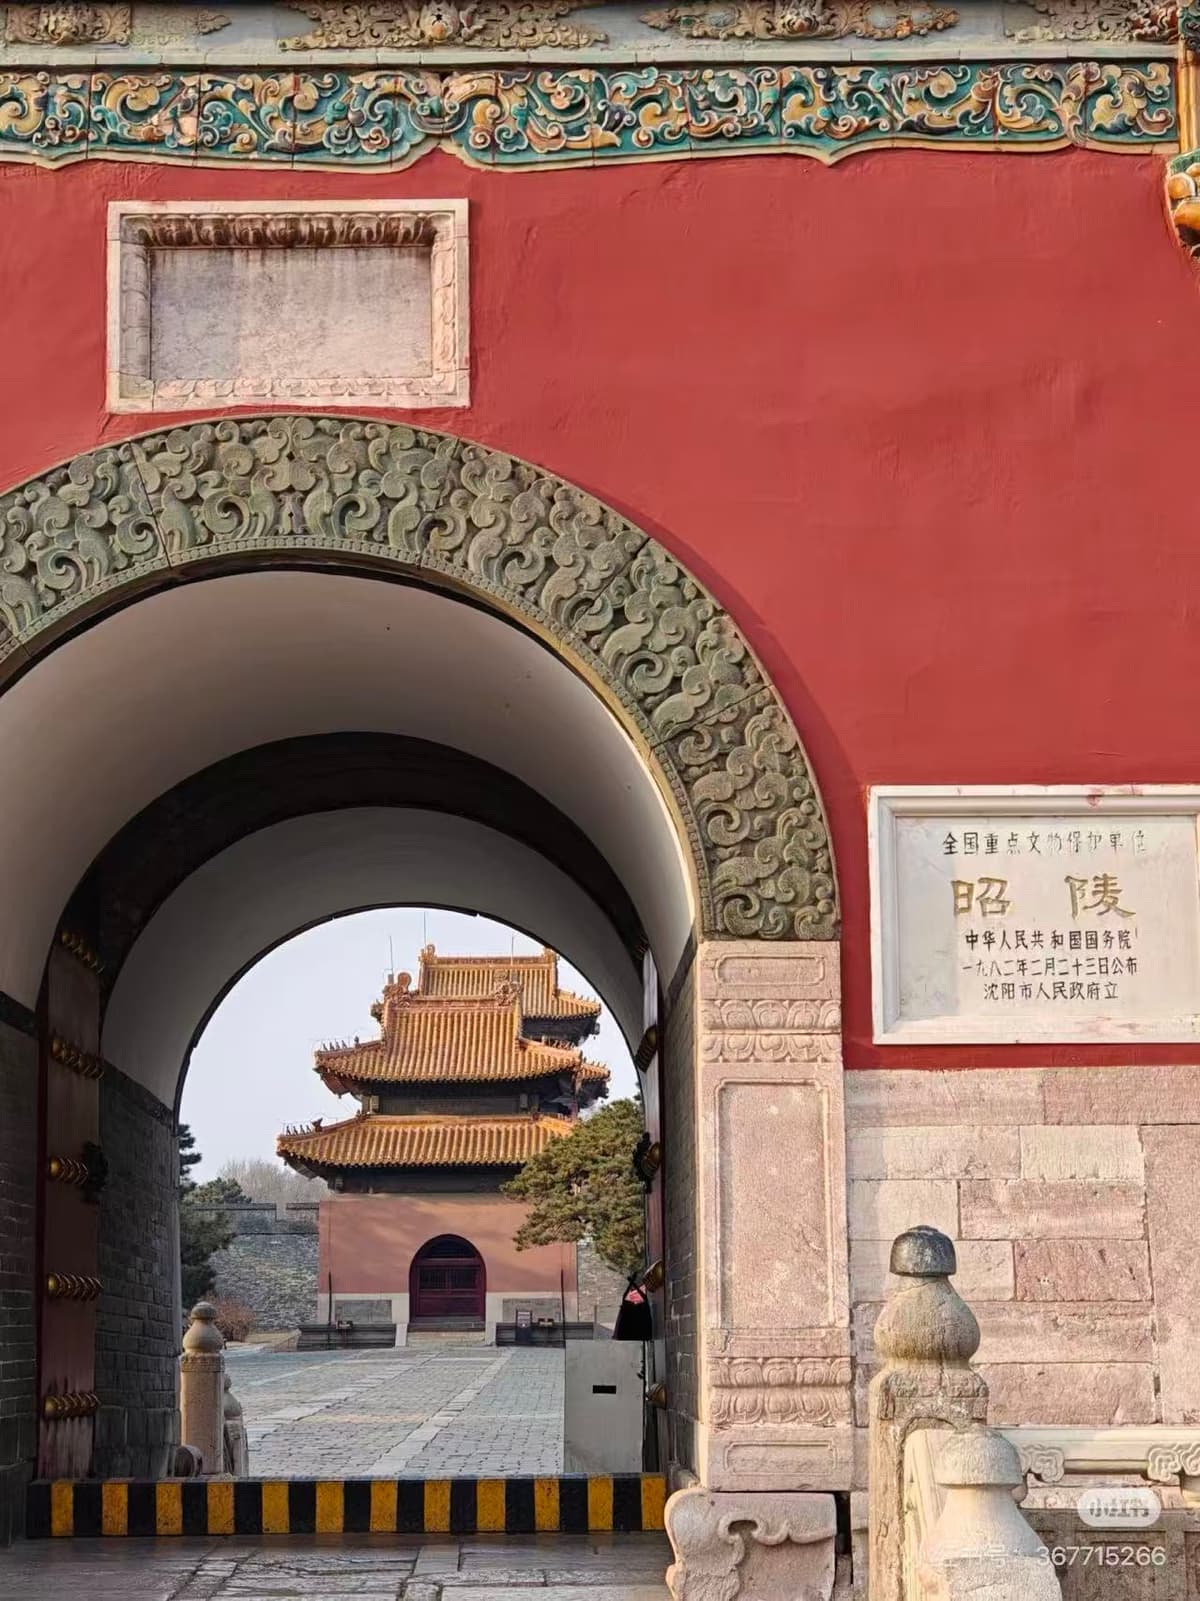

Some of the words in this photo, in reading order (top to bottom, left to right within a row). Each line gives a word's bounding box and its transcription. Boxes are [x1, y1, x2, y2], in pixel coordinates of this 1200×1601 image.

[942, 830, 1146, 856] 全国重点文物保护单位
[951, 872, 1137, 920] 昭陵
[965, 929, 1132, 951] 中华人民共和国国务院
[962, 956, 1138, 977] 一九八二年二月二十三日公布
[983, 981, 1119, 1001] 沈阳市人民政府立
